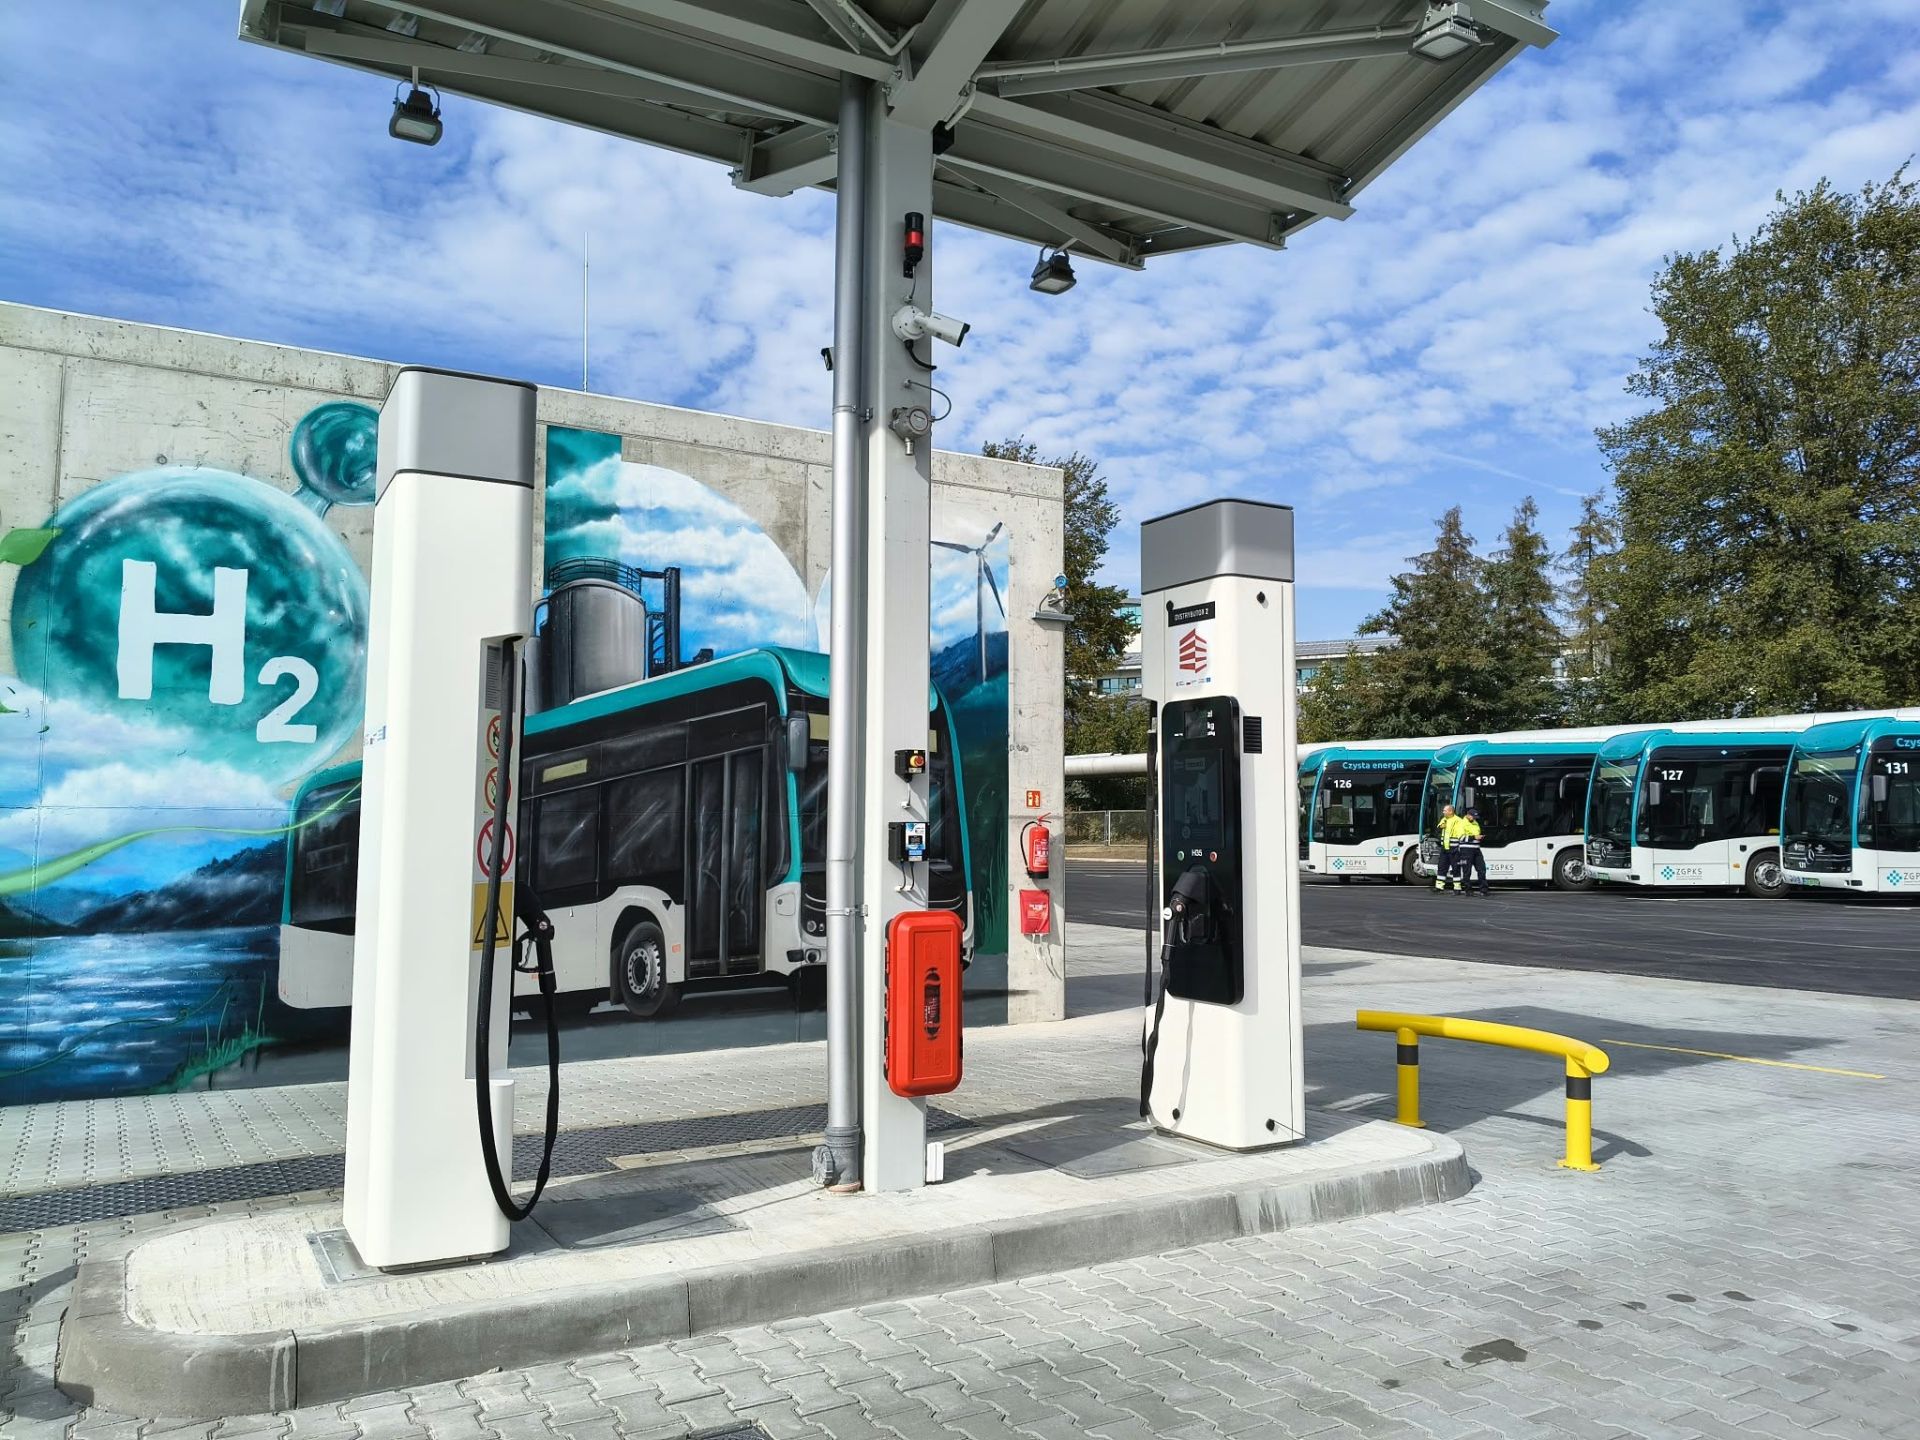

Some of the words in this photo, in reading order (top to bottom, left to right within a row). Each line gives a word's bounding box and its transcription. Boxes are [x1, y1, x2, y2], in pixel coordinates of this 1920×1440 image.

[1342, 761, 1371, 771] Czysta
[1372, 761, 1405, 771] energia
[1885, 762, 1909, 774] 131
[1661, 770, 1684, 781] 127
[1333, 780, 1352, 789] 126
[1476, 776, 1496, 786] 130
[1191, 849, 1203, 857] H35
[1676, 868, 1703, 876] ZGPKS
